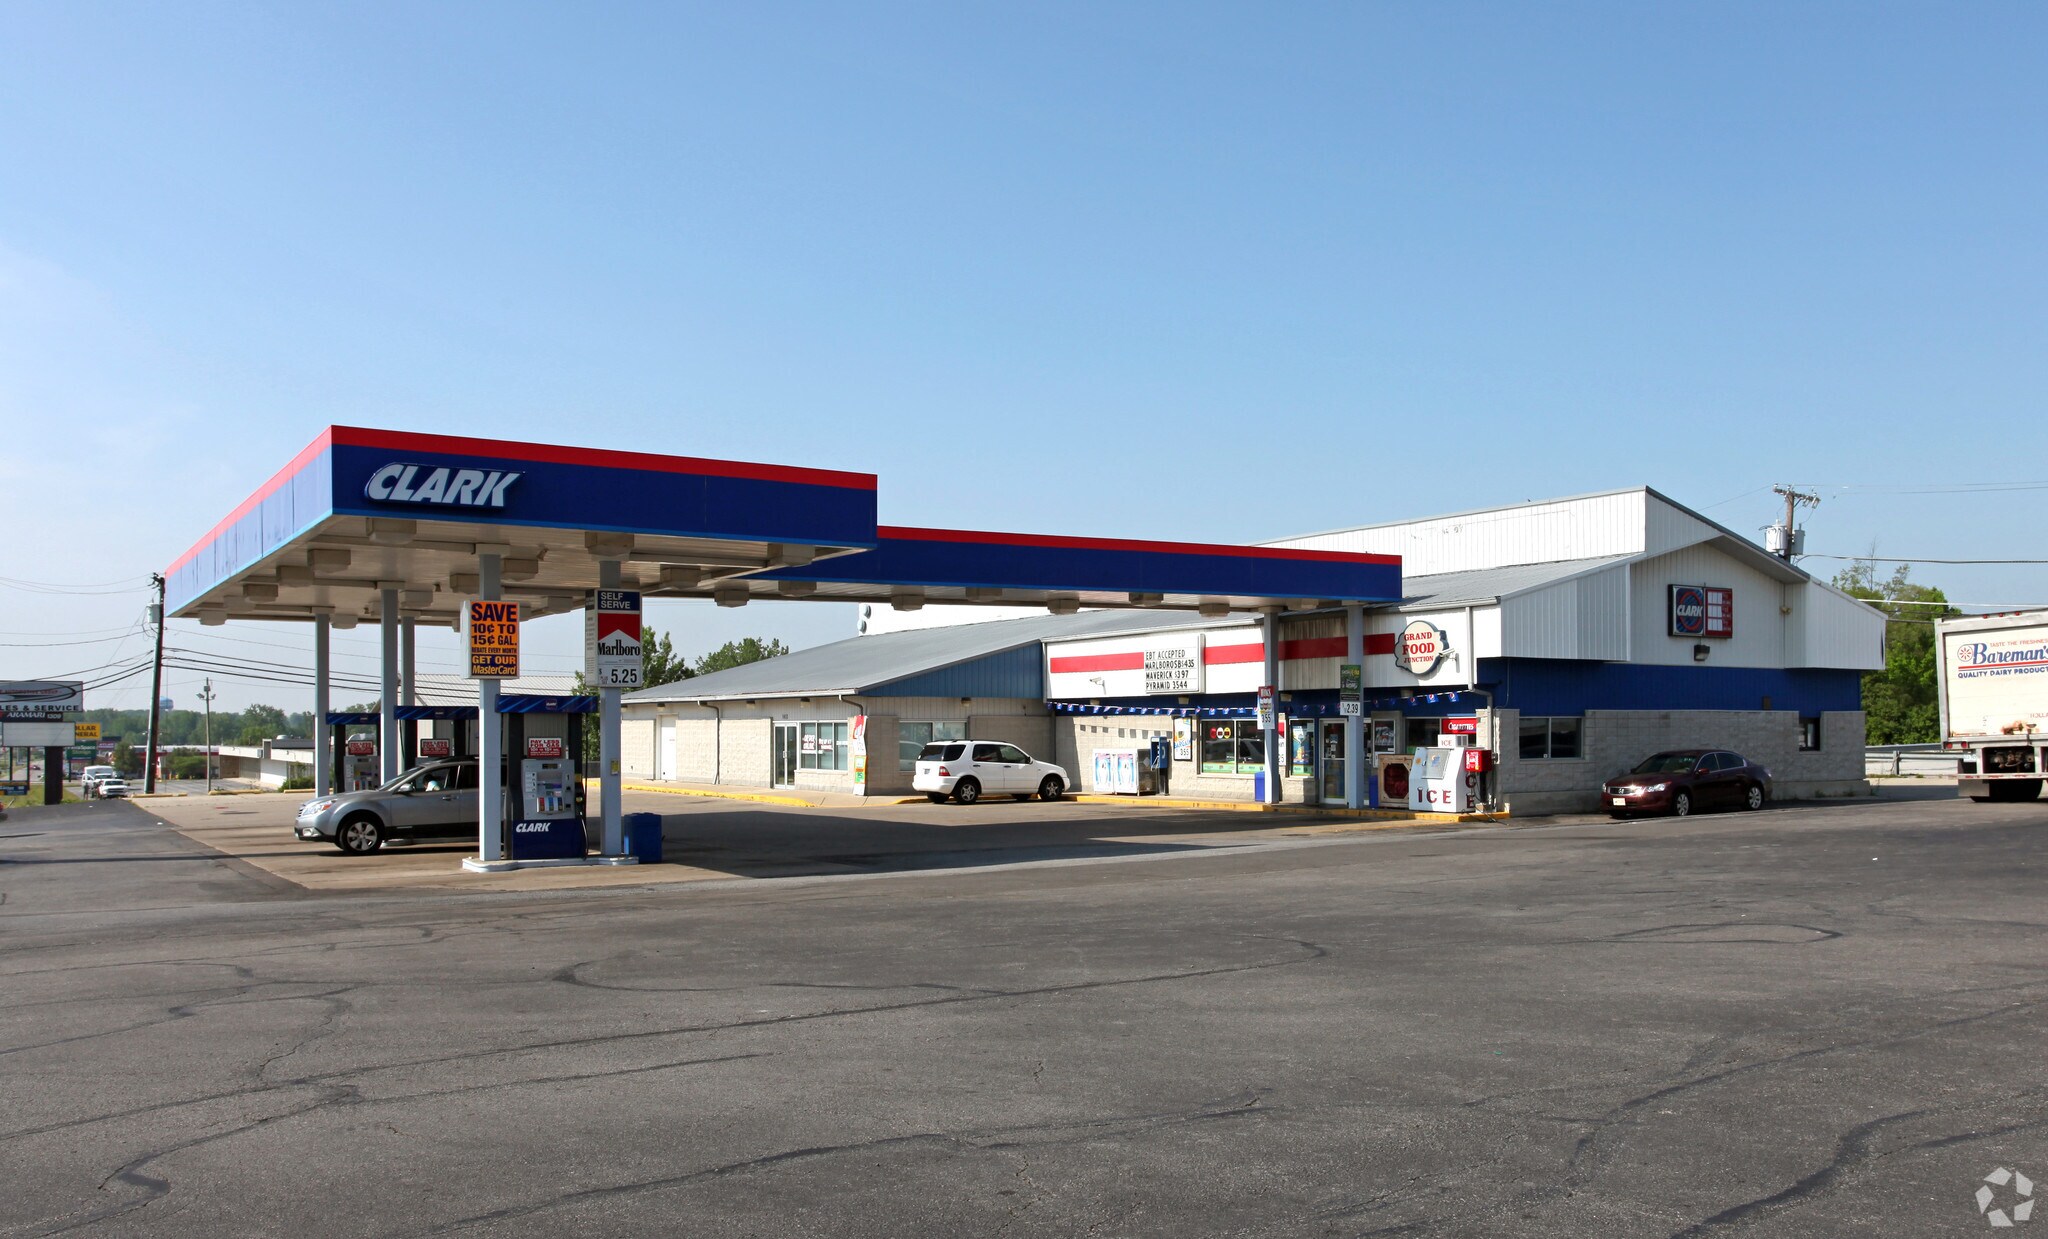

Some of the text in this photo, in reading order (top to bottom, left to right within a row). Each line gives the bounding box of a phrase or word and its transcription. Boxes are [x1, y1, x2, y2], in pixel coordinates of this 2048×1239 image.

[368, 464, 520, 507] CLARK
[601, 592, 623, 600] SELF
[601, 600, 630, 609] SERVE
[471, 603, 517, 622] SAVE
[1677, 604, 1703, 616] CLARK
[472, 624, 515, 634] 10¢ TO
[472, 635, 517, 646] 15¢ GAL.
[1404, 632, 1432, 641] GRAND
[598, 639, 640, 656] Marlboro
[1402, 642, 1435, 655] FOOD
[1146, 649, 1185, 660] EBT ACCEPTED
[1404, 655, 1433, 663] JUNCTION
[472, 655, 516, 665] GET OUR
[472, 665, 516, 675] MasterCard
[1146, 671, 1172, 679] MAVERICK
[611, 668, 637, 683] 5.25
[1146, 681, 1170, 690] PYRAMID
[1346, 704, 1358, 713] 2.39
[1418, 788, 1451, 804] ICE
[515, 823, 551, 833] CLARK
